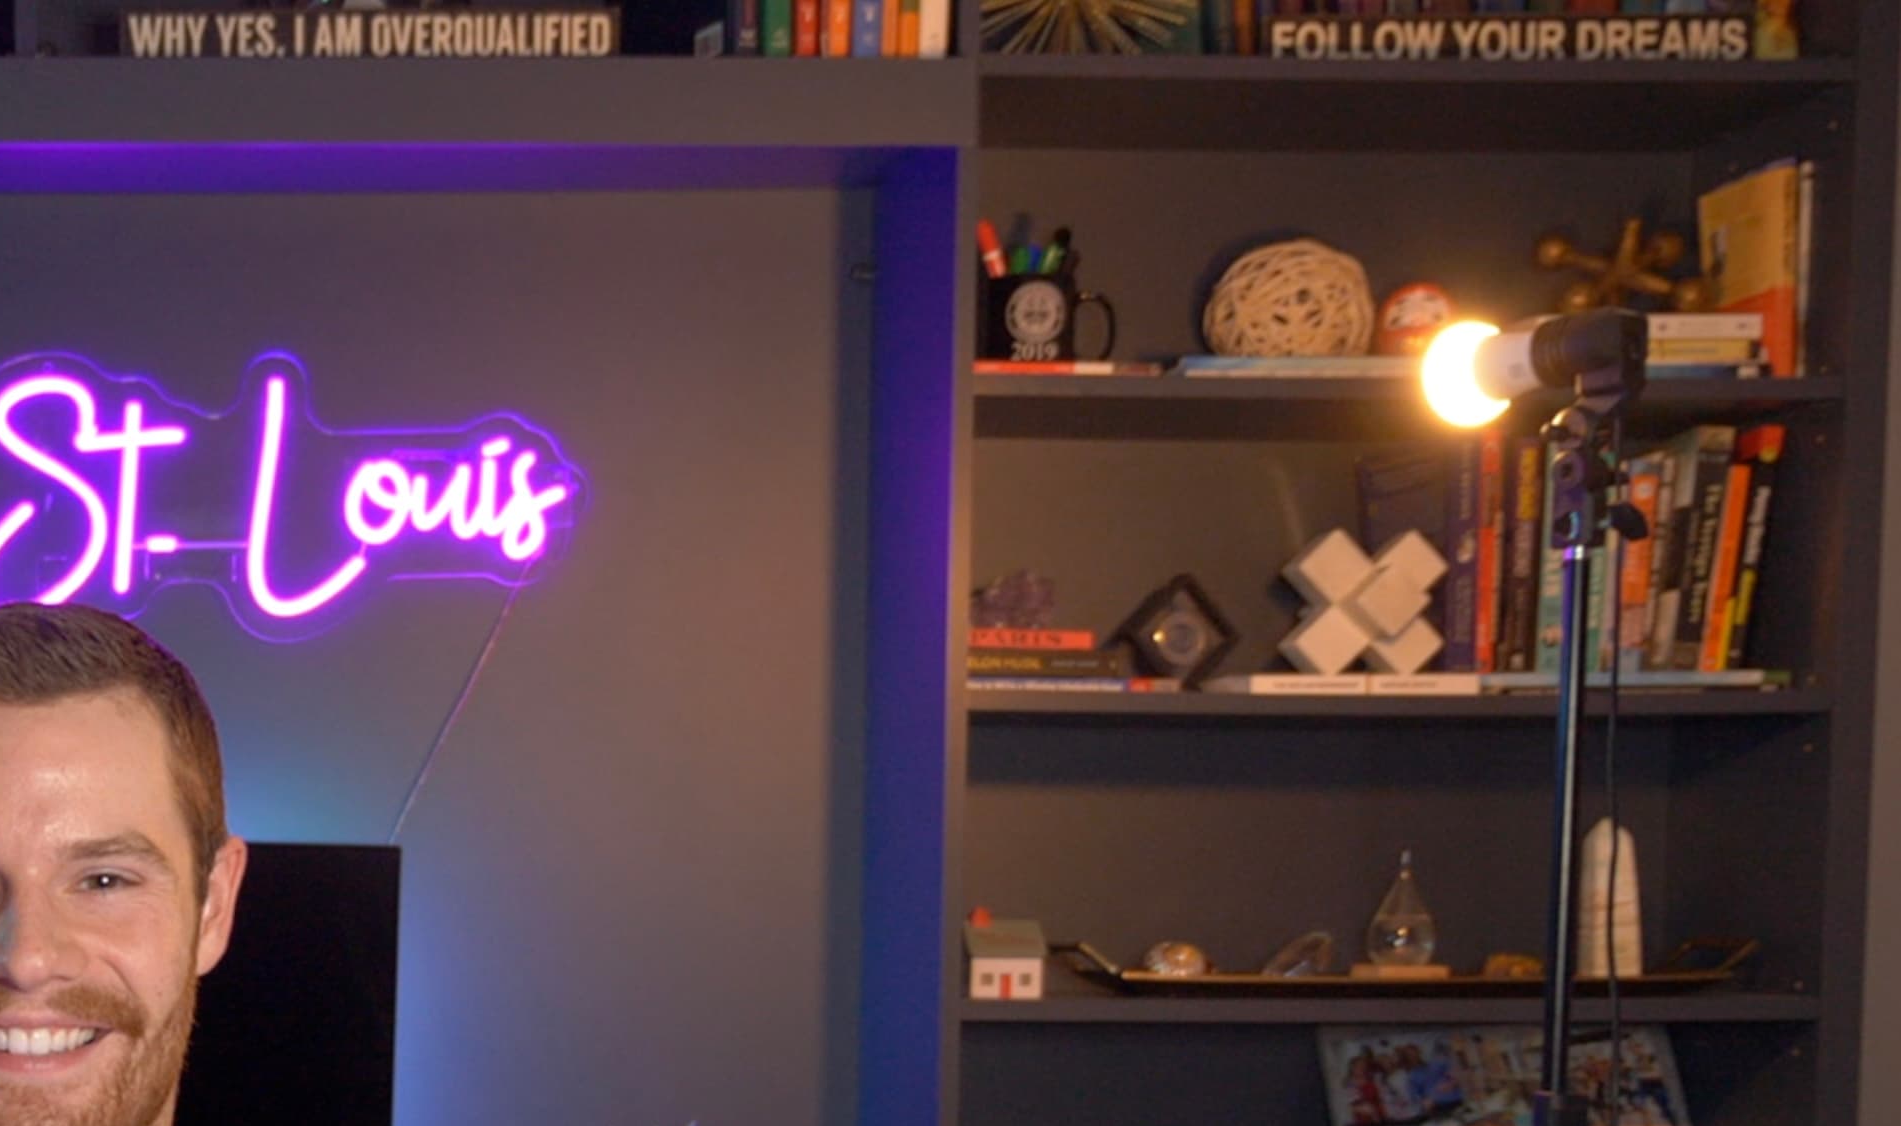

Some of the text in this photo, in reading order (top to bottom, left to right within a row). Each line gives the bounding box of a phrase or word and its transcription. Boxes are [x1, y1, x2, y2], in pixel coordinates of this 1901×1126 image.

[127, 15, 207, 57] WHY
[293, 15, 305, 57] I
[313, 15, 363, 57] AM
[370, 15, 611, 57] OVERQUALIFIED
[1271, 18, 1748, 60] FOLLOW YOUR DREAMS
[1010, 341, 1059, 361] 2019
[245, 376, 569, 618] Louis
